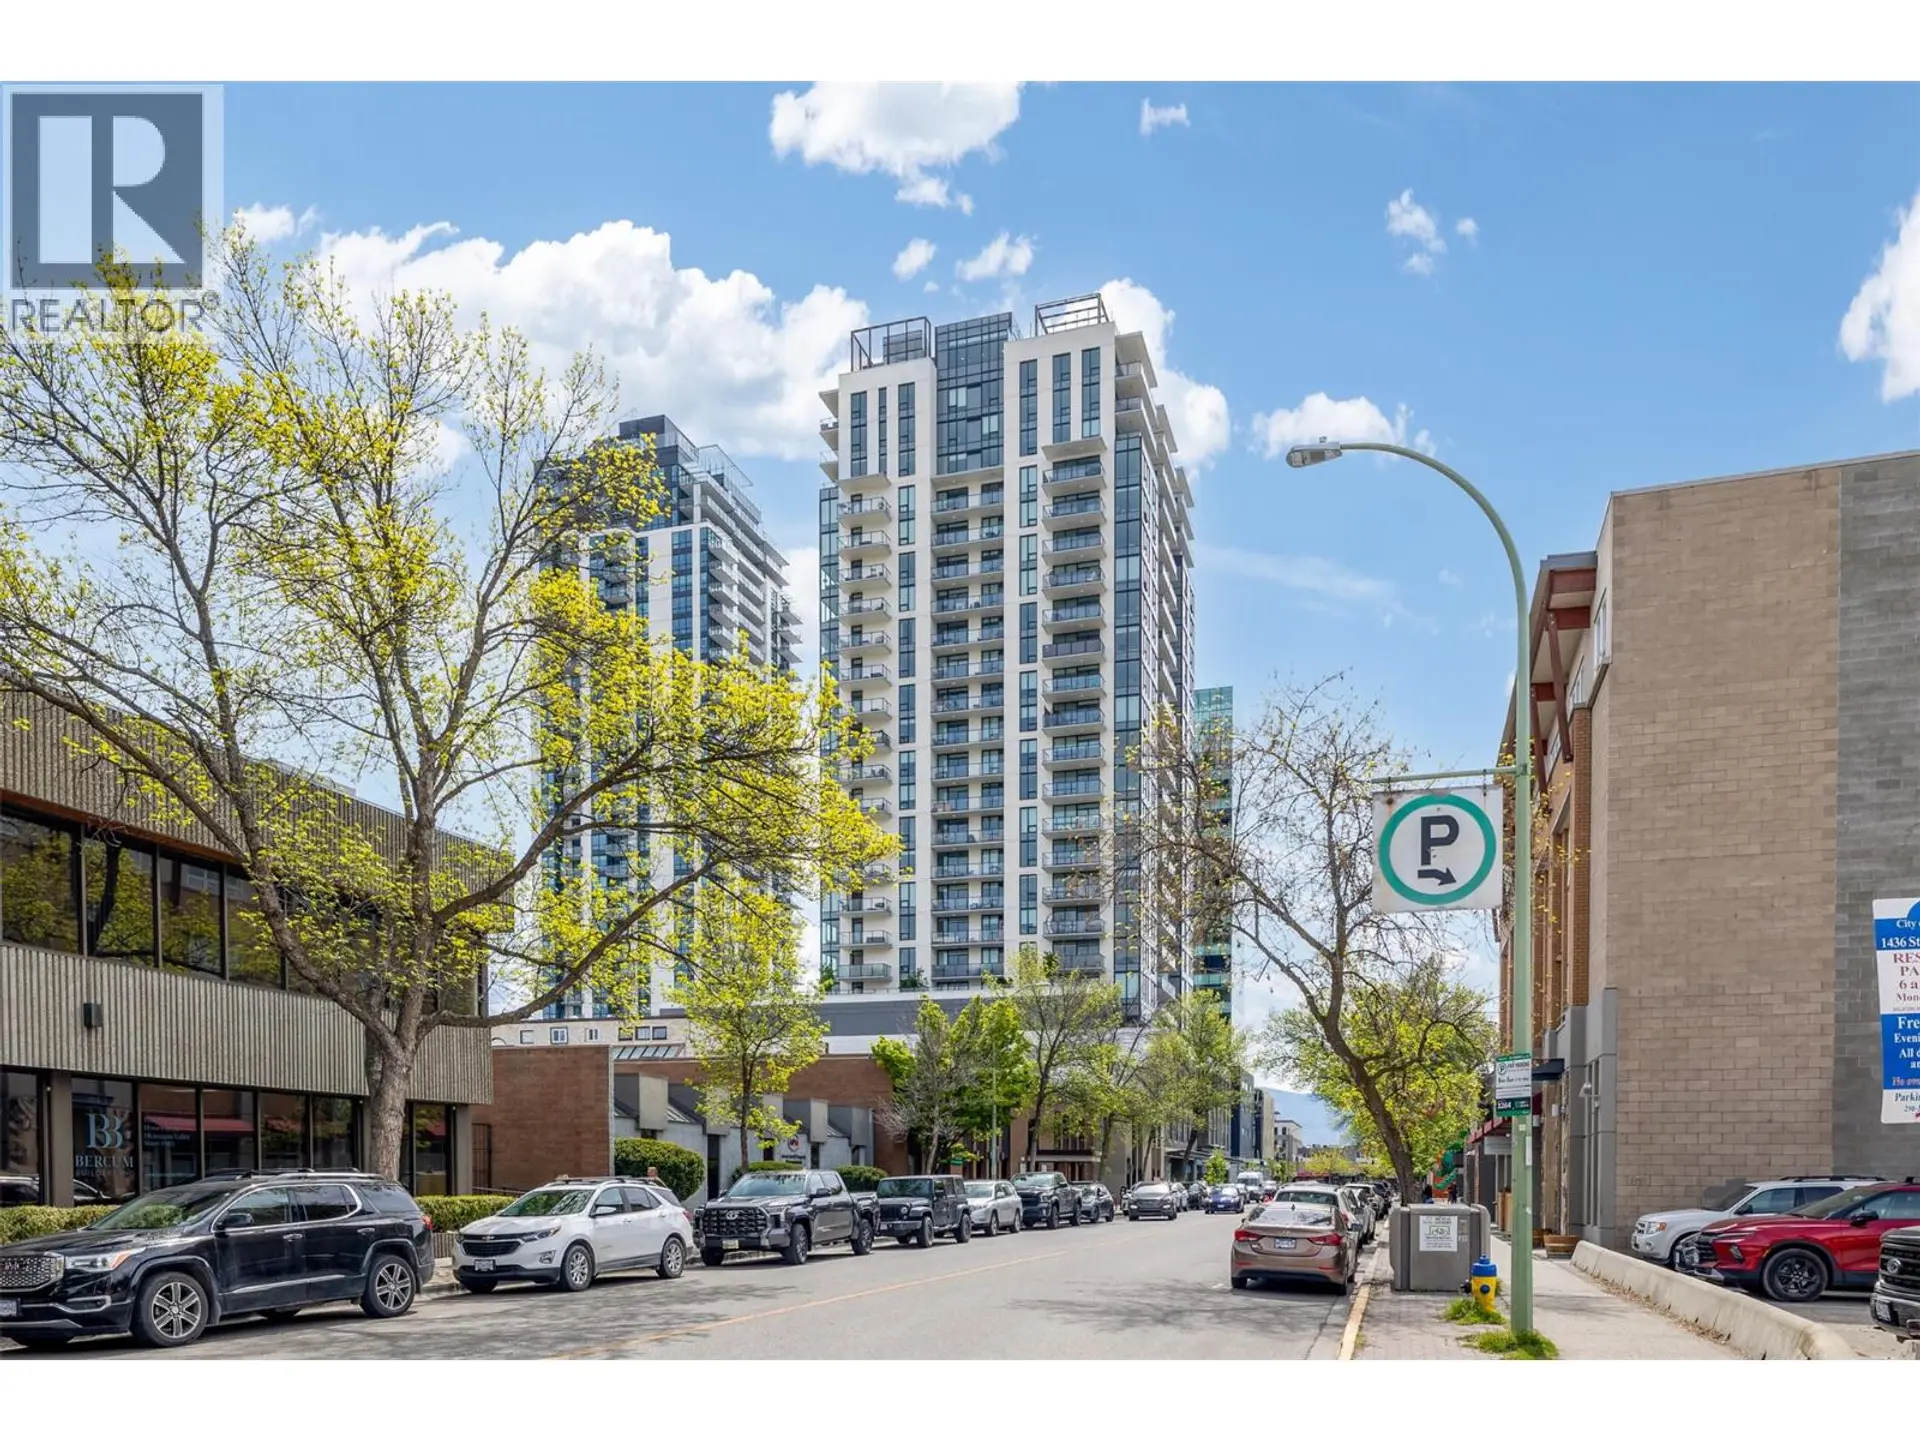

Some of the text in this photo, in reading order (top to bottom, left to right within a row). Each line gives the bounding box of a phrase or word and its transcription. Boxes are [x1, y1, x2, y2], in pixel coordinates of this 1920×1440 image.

[1420, 815, 1460, 866] P
[1896, 919, 1916, 930] City
[1881, 937, 1907, 948] 1436
[1900, 966, 1919, 976] PA
[1899, 979, 1907, 990] 6
[1899, 1048, 1914, 1059] All
